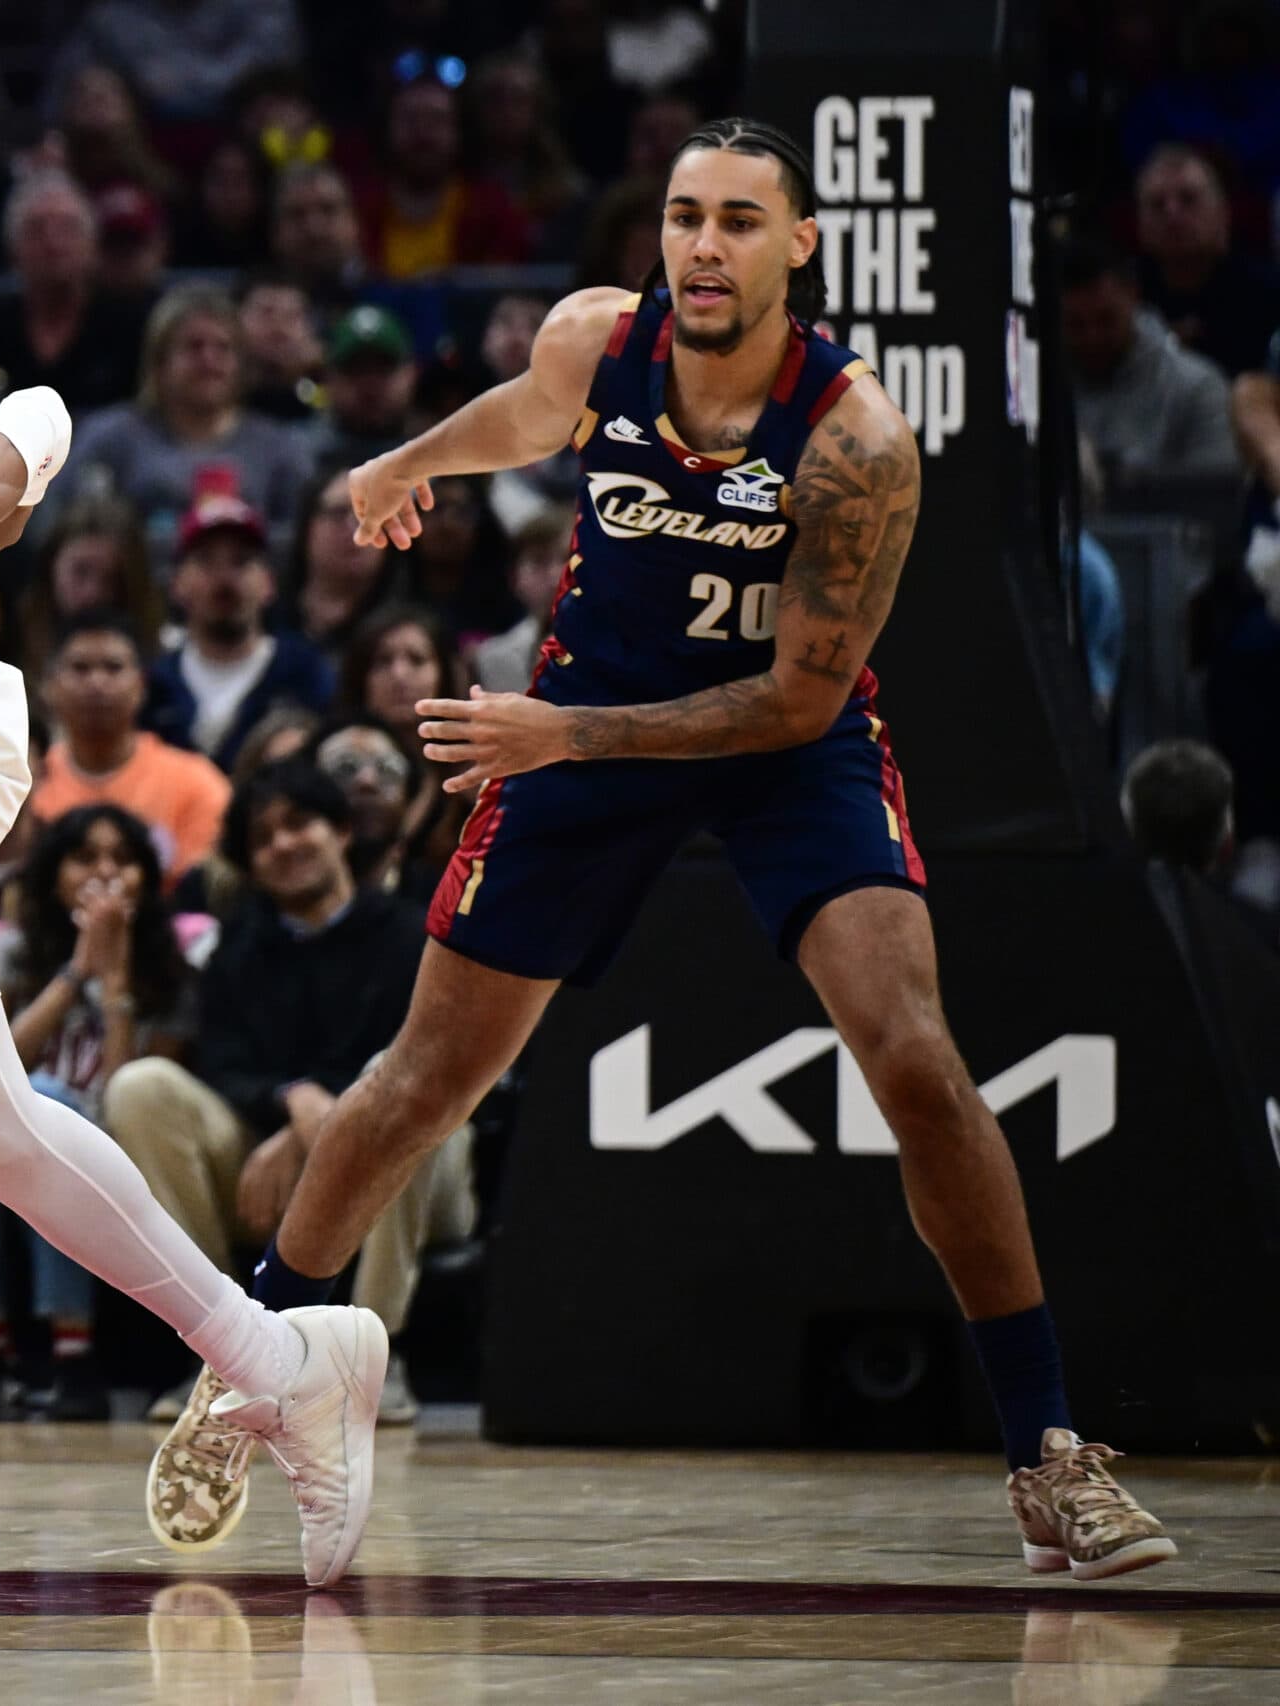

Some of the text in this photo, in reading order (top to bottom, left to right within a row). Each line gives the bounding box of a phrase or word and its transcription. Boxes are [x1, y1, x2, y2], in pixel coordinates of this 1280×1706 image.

[814, 95, 935, 203] GET
[816, 207, 937, 315] THE
[685, 572, 780, 641] 20
